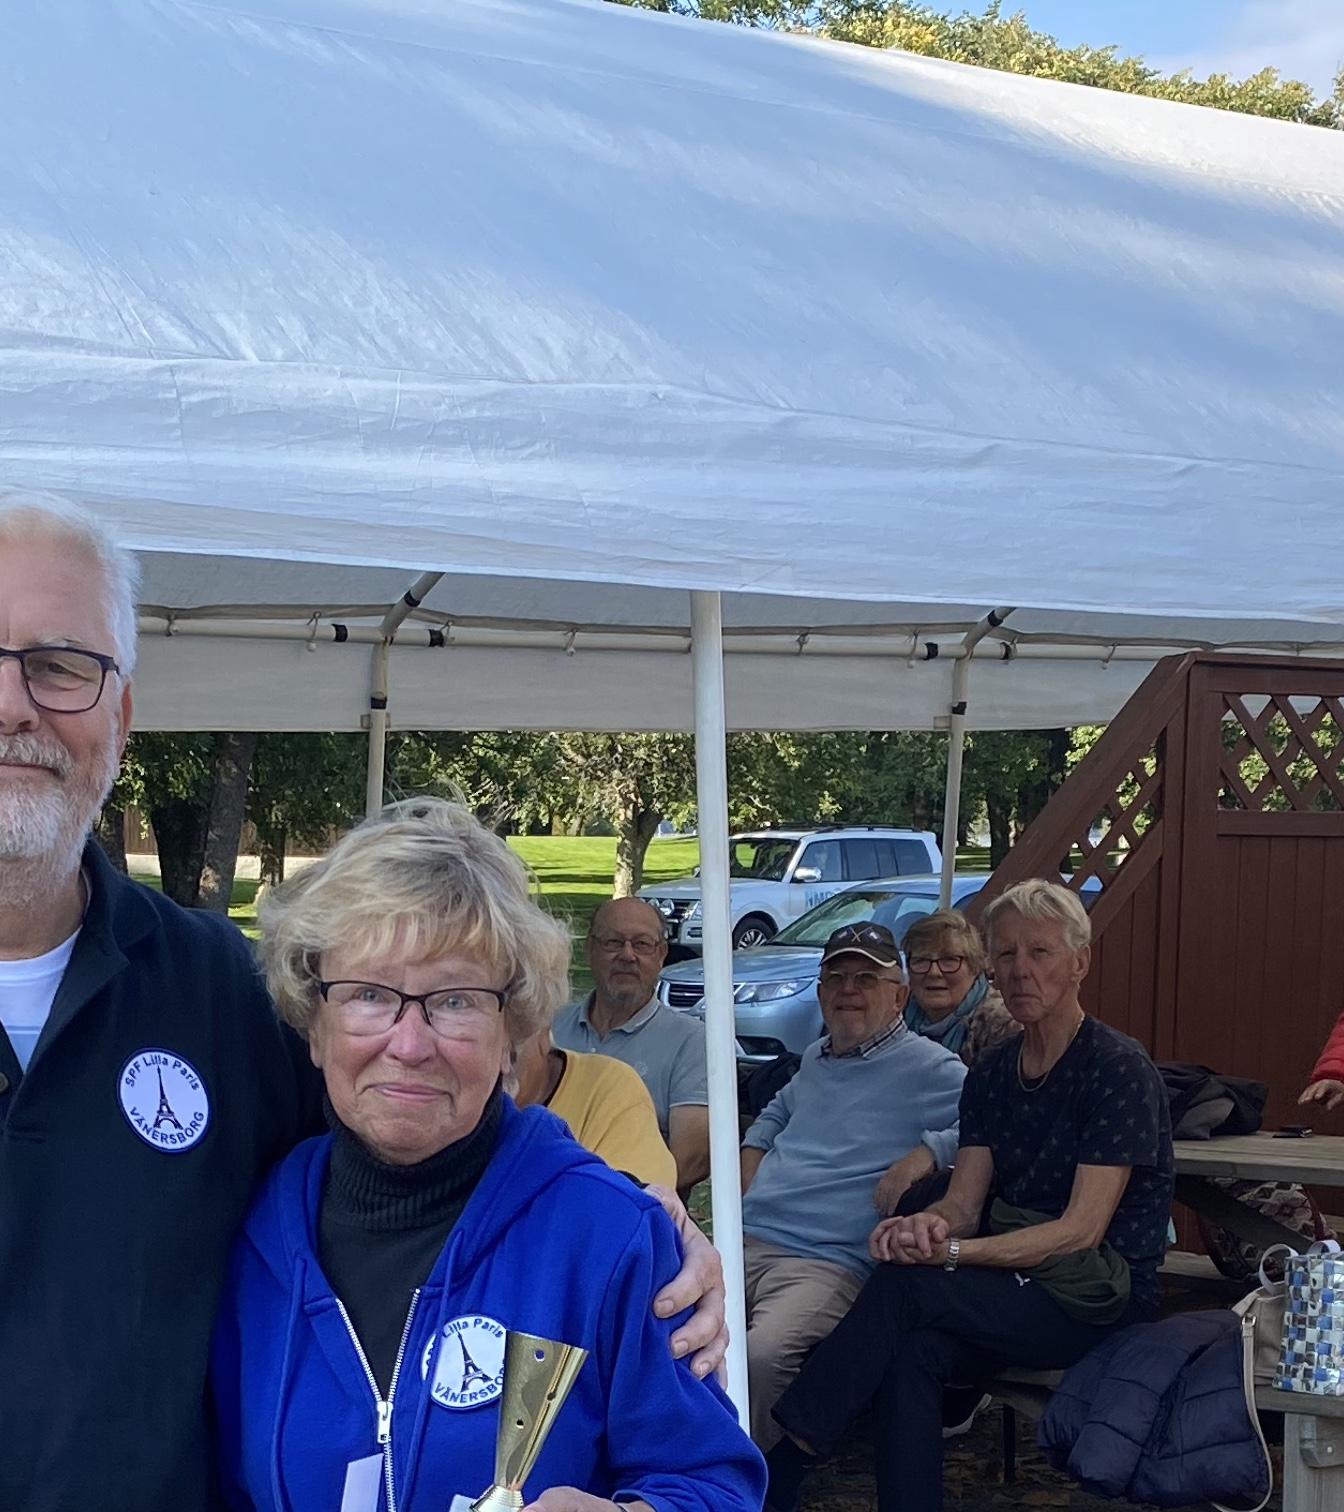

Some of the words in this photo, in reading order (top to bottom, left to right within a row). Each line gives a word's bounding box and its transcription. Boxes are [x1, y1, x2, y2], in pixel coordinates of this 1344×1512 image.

[125, 1061, 142, 1088] SPF
[142, 1054, 169, 1067] Lilla
[172, 1059, 200, 1091] Paris
[130, 1106, 205, 1145] VÄNERSBORG
[442, 1320, 469, 1339] Lilla
[473, 1318, 504, 1338] Paris
